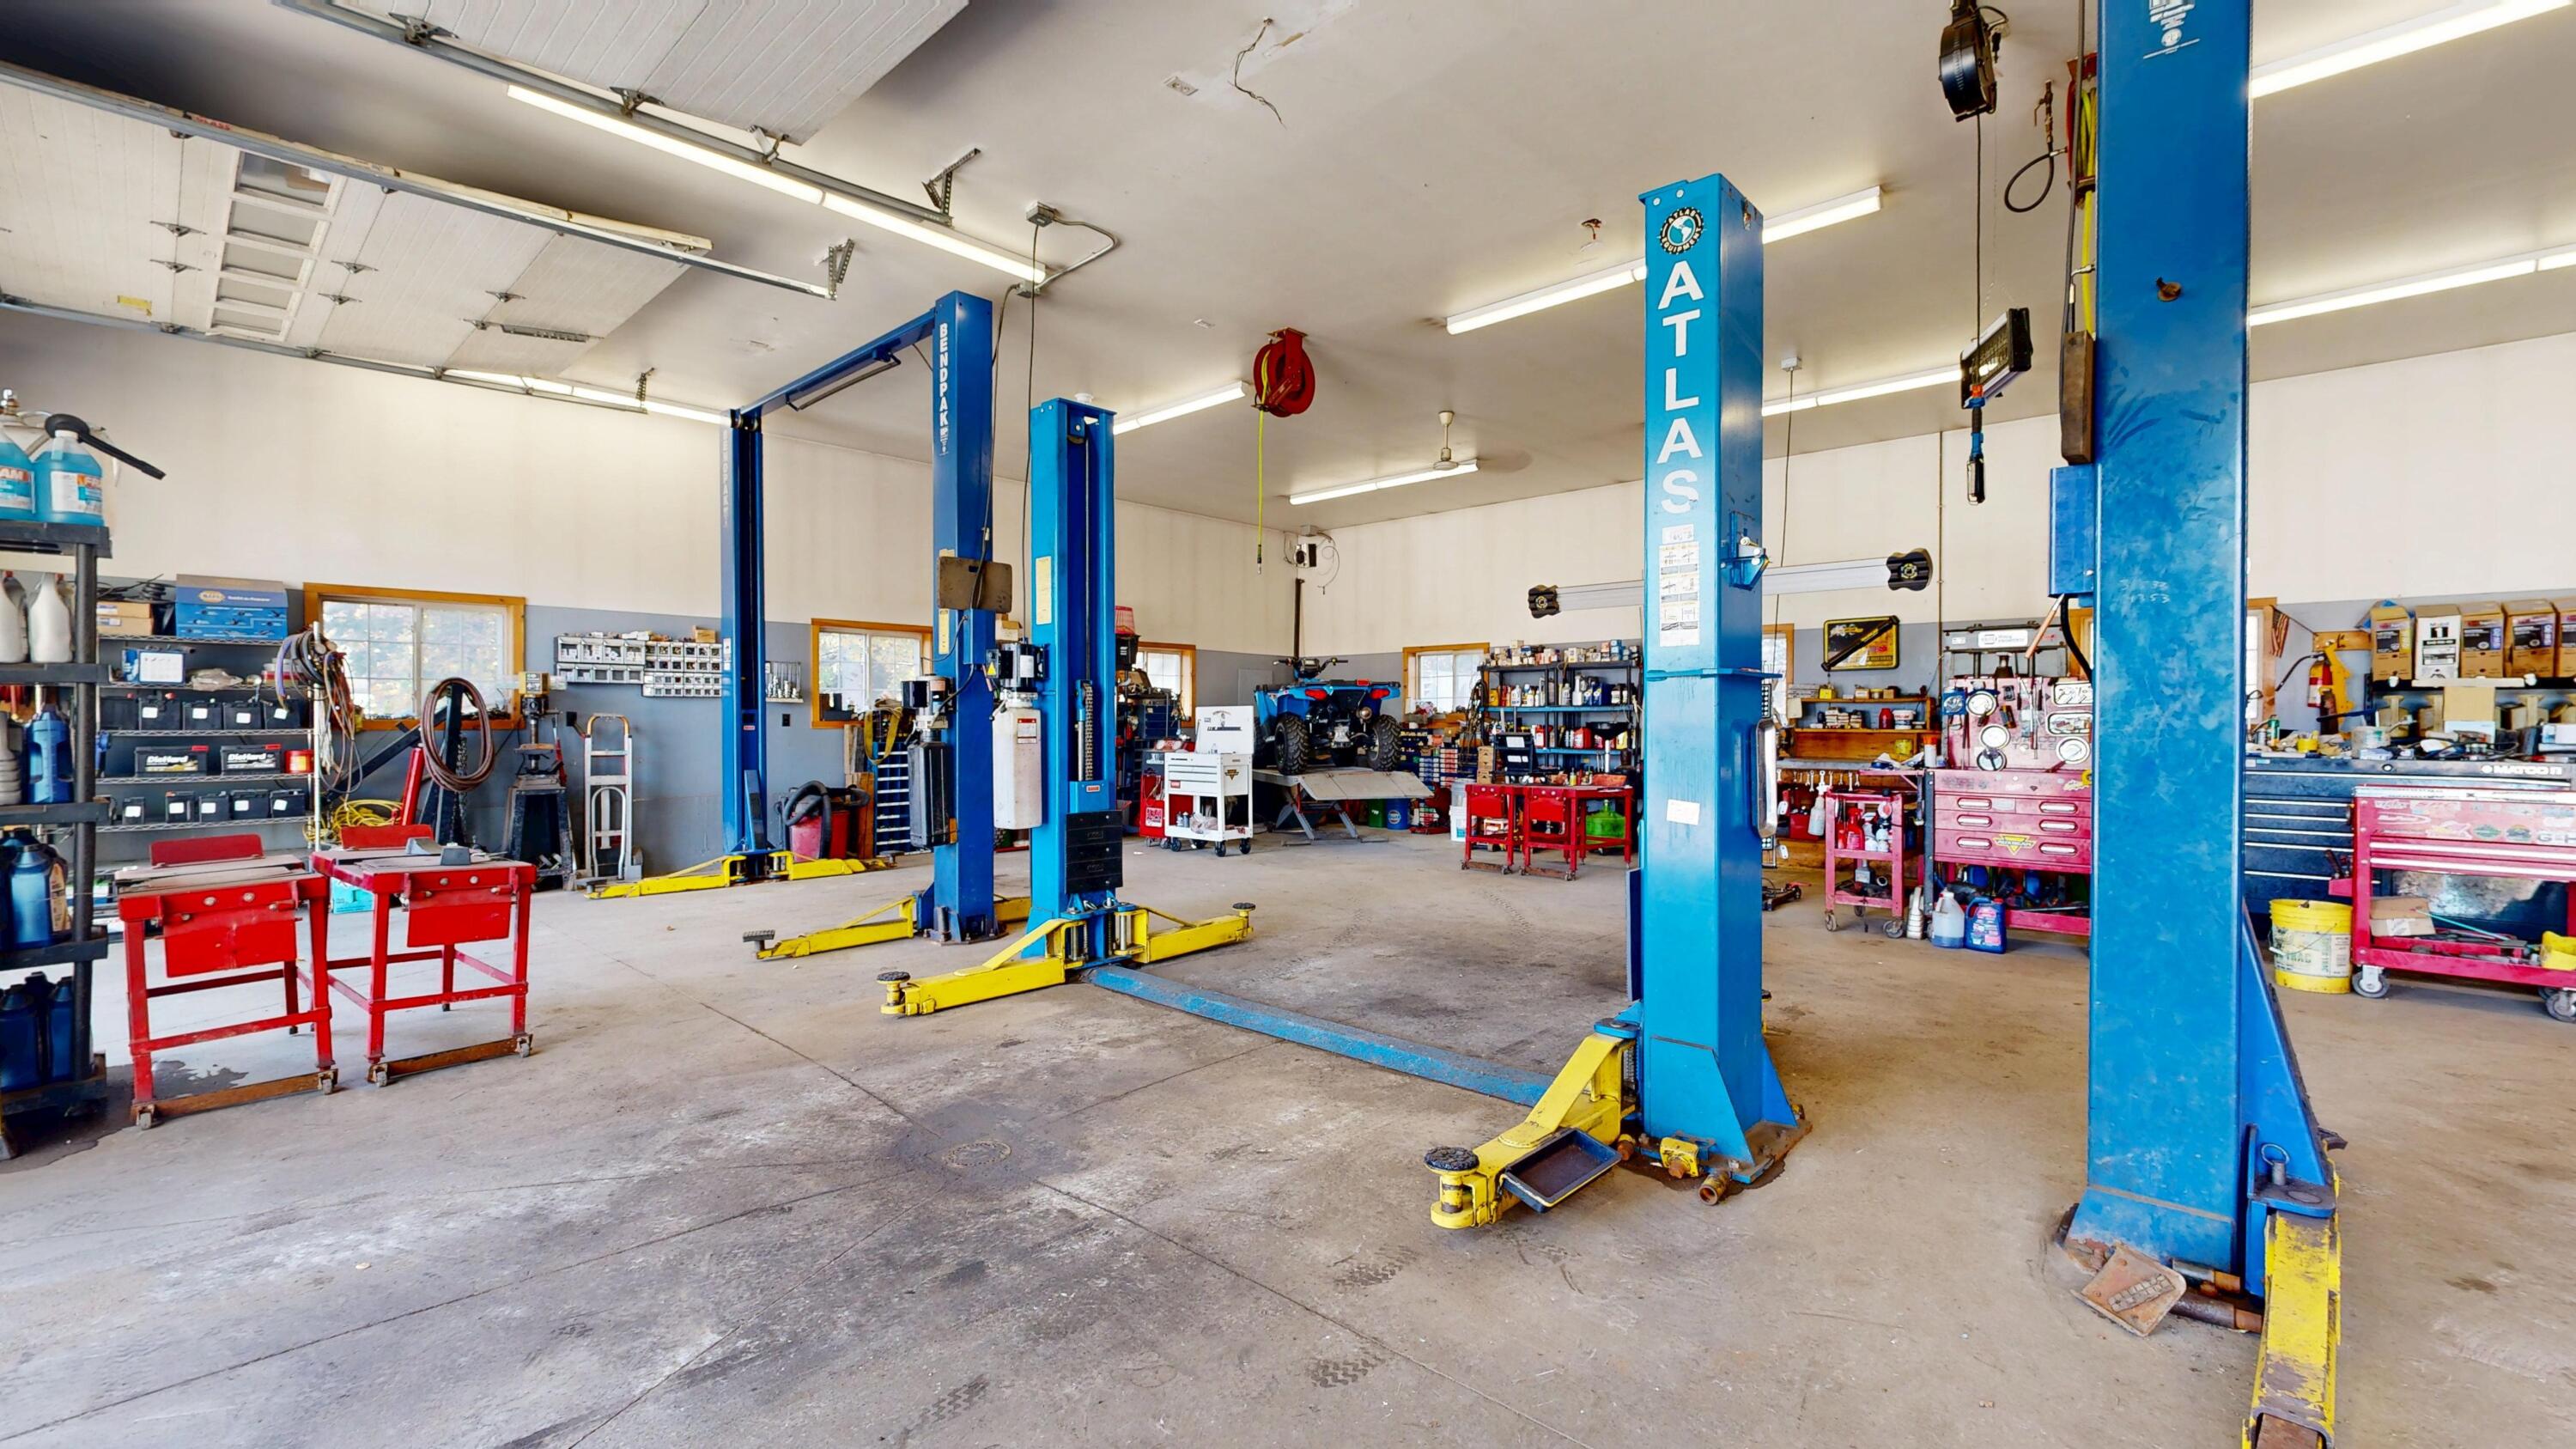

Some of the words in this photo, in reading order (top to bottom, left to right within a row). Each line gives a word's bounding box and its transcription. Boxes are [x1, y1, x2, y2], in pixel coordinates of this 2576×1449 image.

[1668, 208, 1697, 223] ATLAS
[1661, 227, 1702, 253] EQUIPMENT
[1656, 260, 1704, 514] ATLAS
[228, 753, 266, 764] DieHard
[2494, 764, 2549, 776] MATCO
